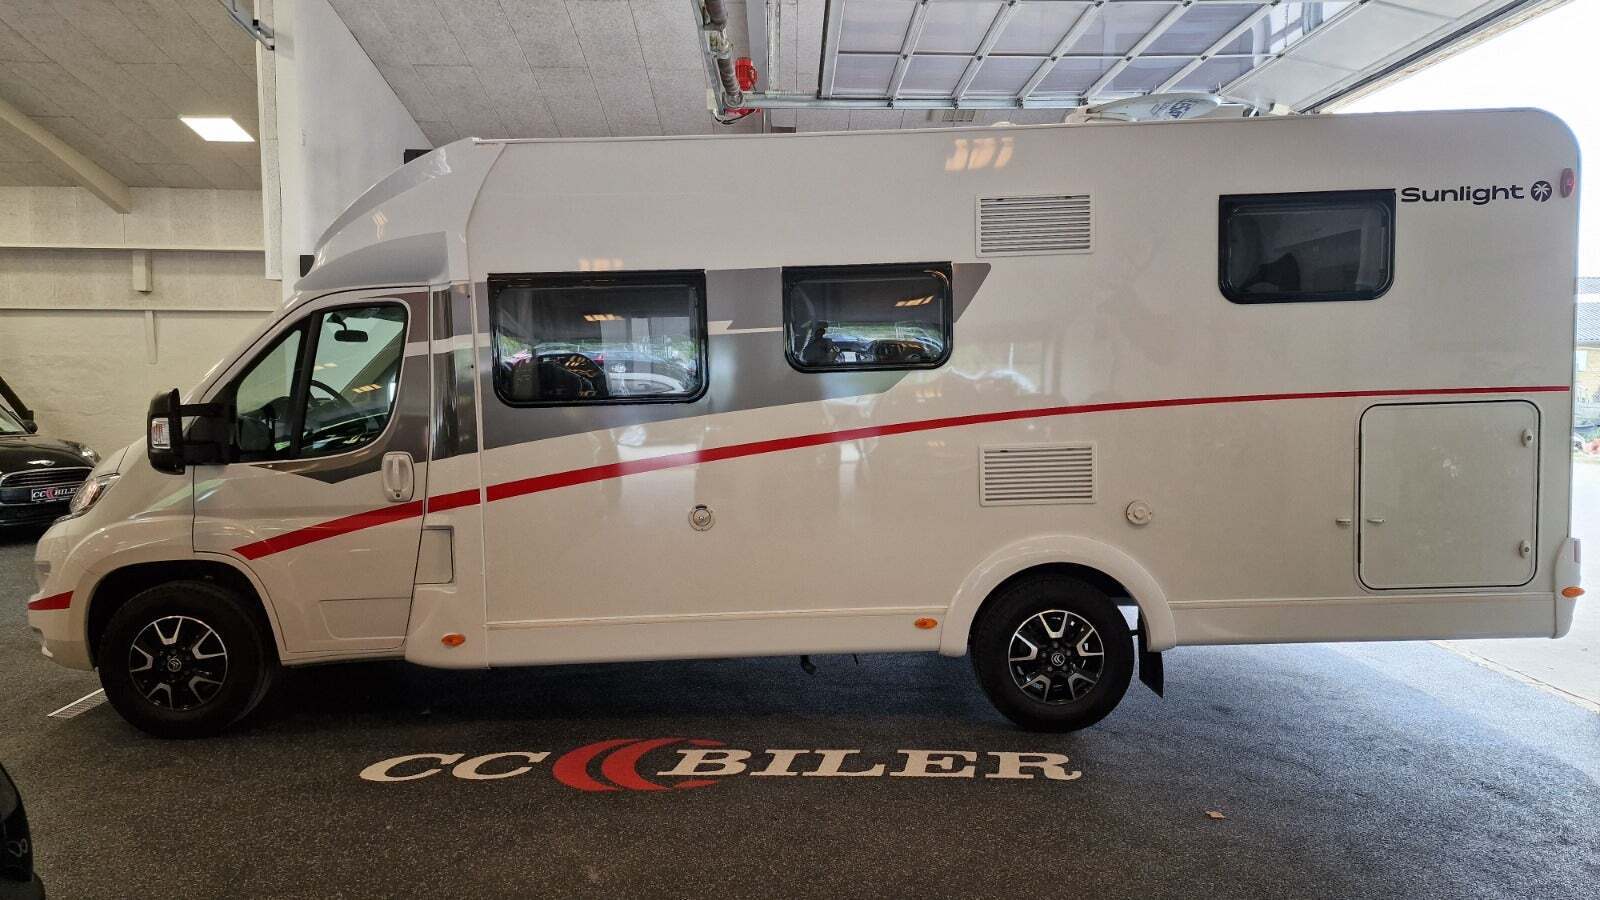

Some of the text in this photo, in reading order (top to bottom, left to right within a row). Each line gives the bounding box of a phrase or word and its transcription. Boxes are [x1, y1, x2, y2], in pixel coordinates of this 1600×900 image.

[1400, 184, 1525, 206] Sunlight
[54, 487, 80, 496] BILE
[359, 749, 1082, 782] CC BILER
